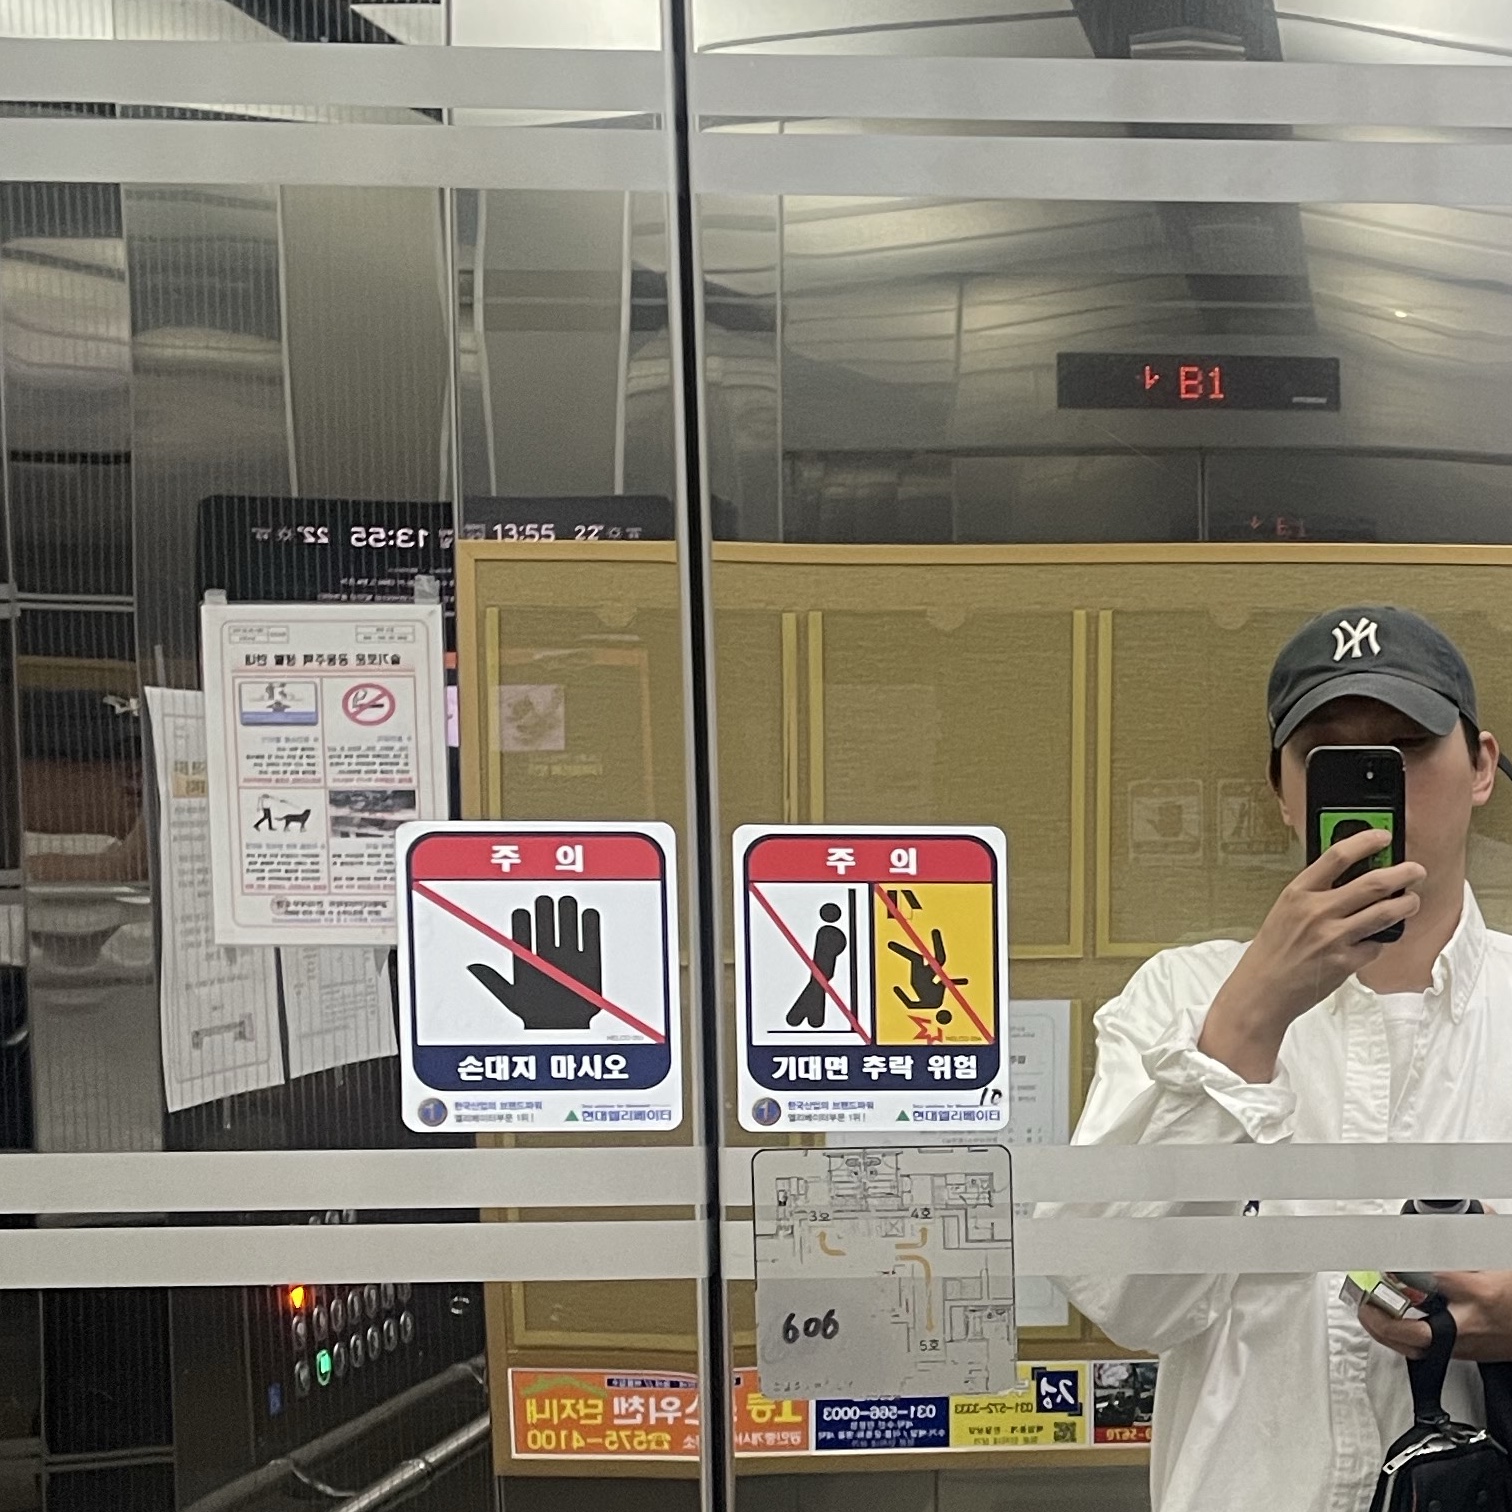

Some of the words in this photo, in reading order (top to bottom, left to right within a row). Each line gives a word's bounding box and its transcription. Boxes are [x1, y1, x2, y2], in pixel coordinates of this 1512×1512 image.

[1179, 364, 1225, 400] B1
[493, 522, 555, 542] 13:55
[457, 1054, 537, 1081] 손대지
[550, 1054, 629, 1080] 마시오
[771, 1055, 849, 1082] 기대면
[862, 1055, 914, 1081] 추락
[927, 1055, 978, 1080] 위험
[782, 1308, 840, 1344] 606
